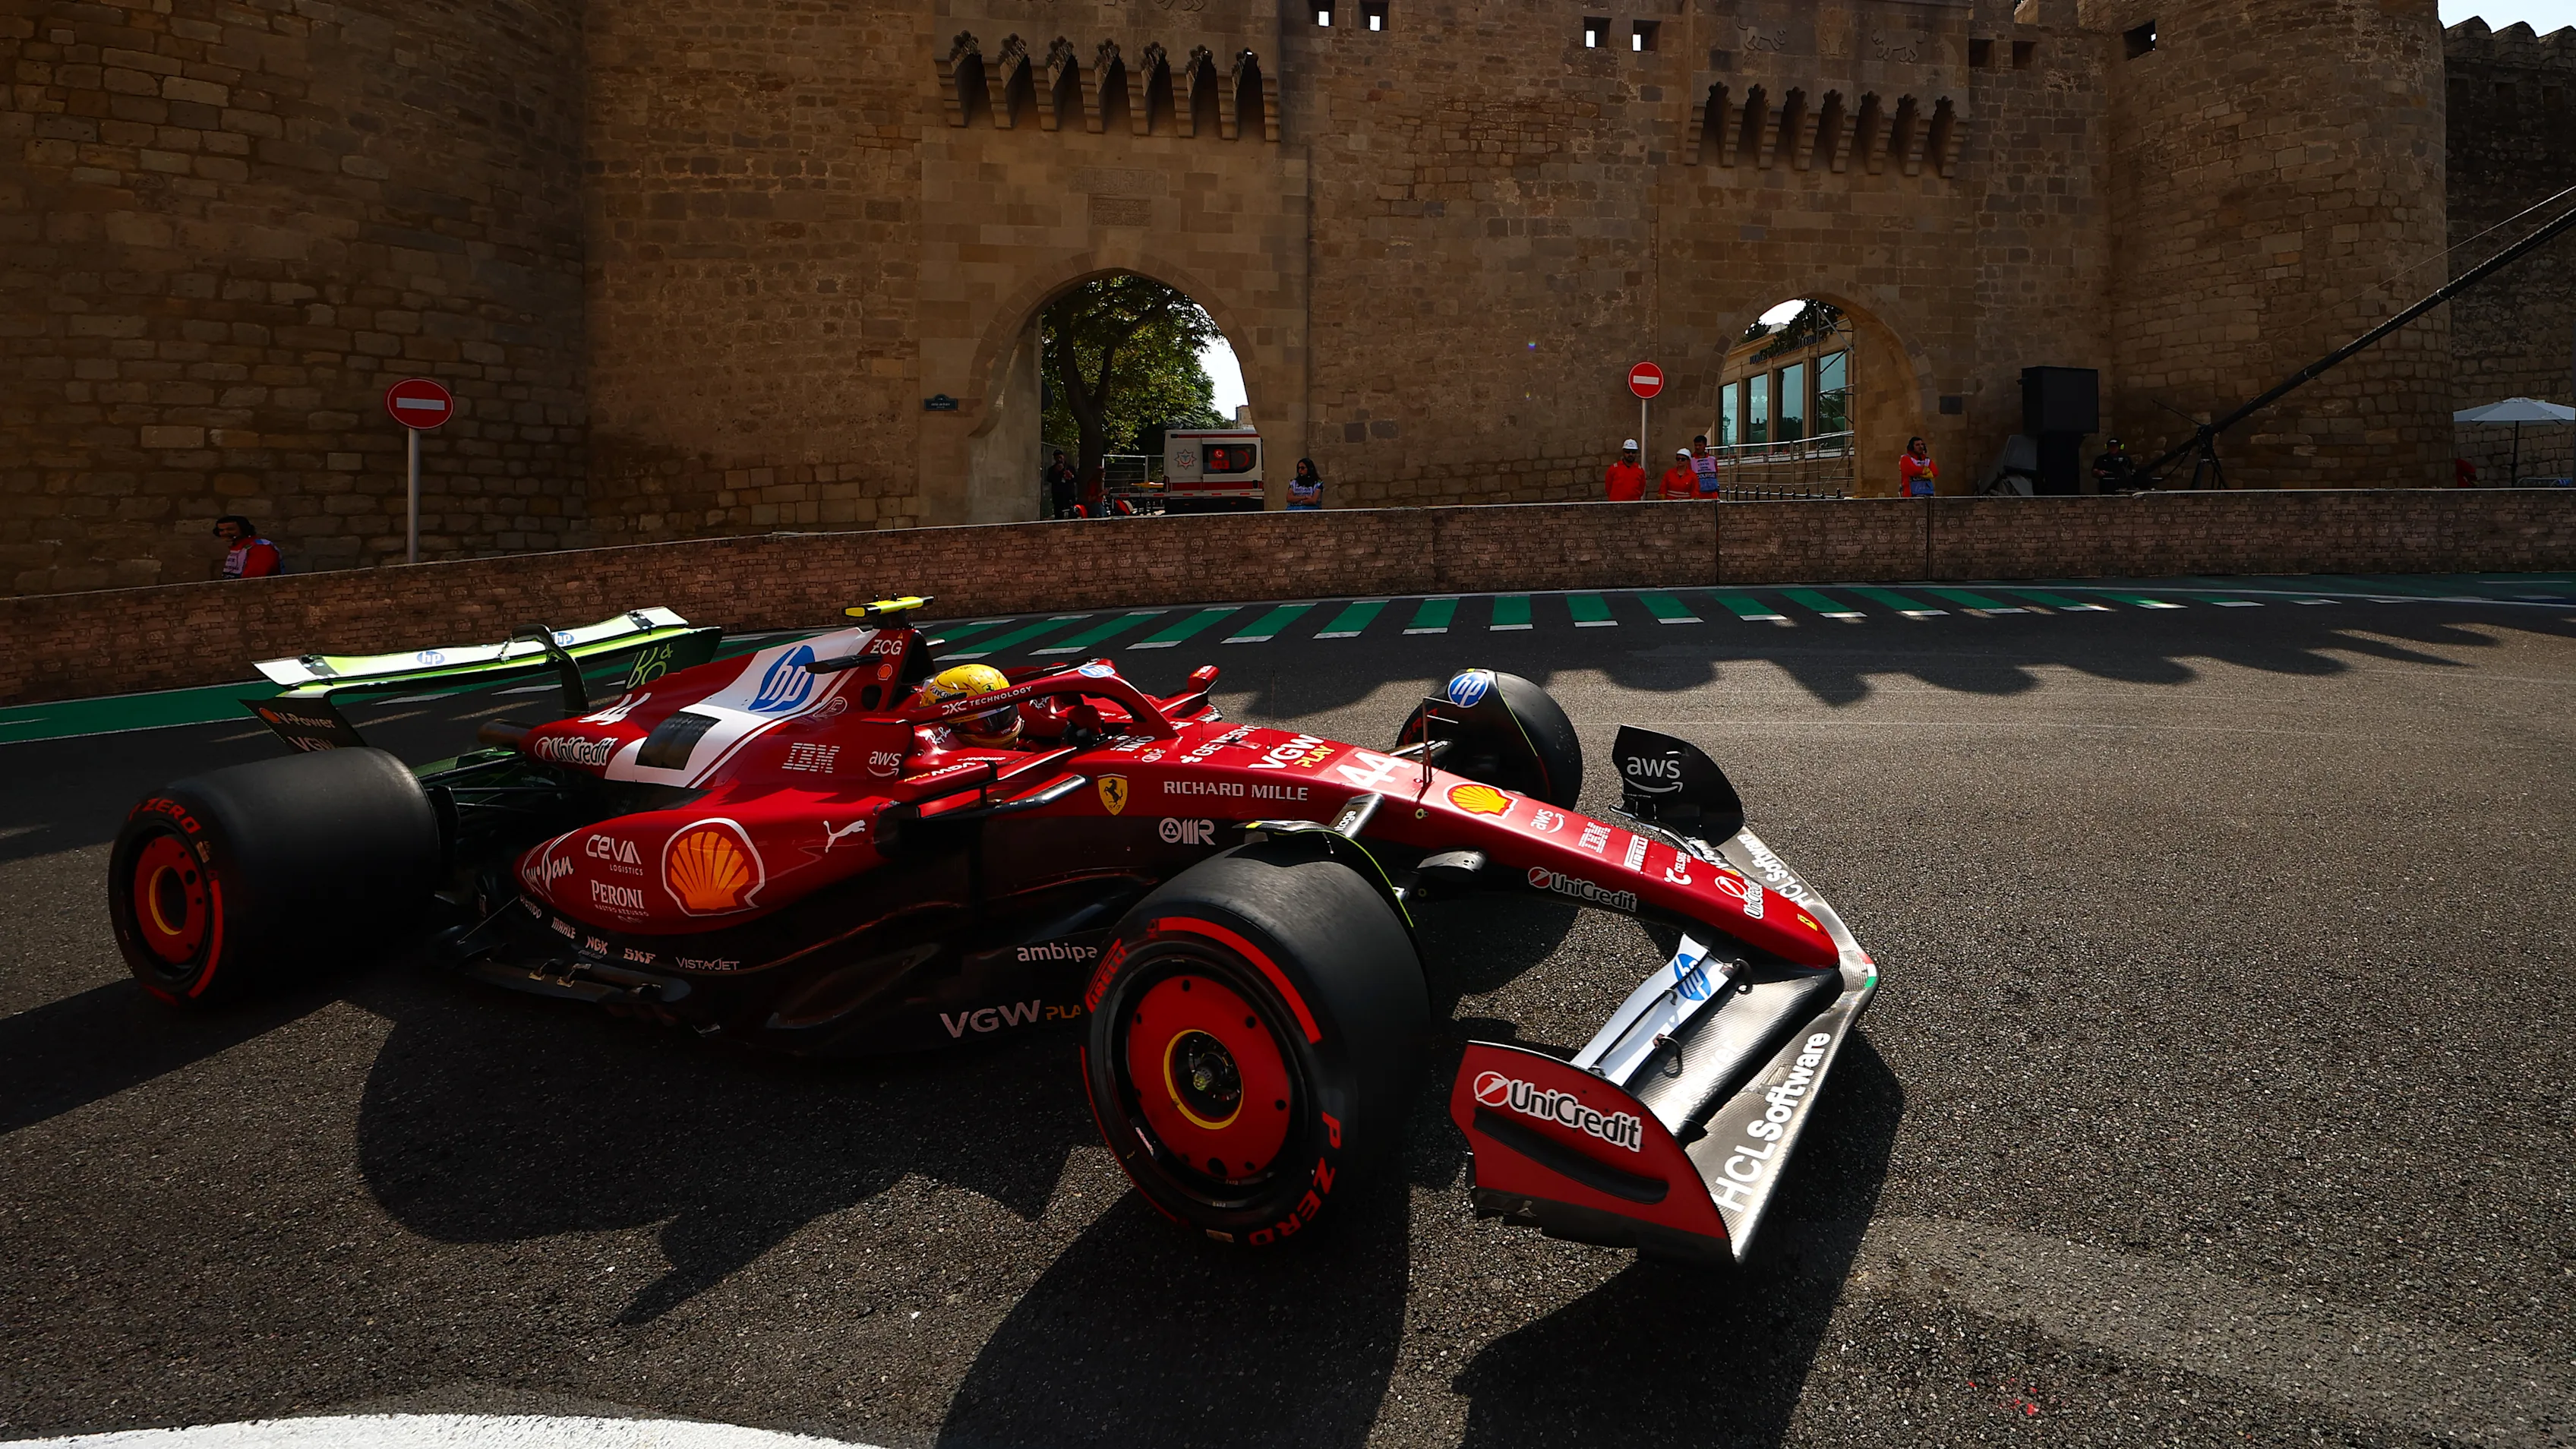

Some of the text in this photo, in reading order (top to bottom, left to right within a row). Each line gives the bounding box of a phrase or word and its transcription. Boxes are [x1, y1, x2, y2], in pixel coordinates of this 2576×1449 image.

[420, 651, 443, 665] hp
[870, 639, 902, 655] ZCG
[970, 686, 1032, 706] TECHNOLOGY
[1451, 674, 1485, 707] hp
[276, 710, 336, 729] V-Power
[578, 693, 652, 725] 44
[549, 737, 618, 766] UniCredit
[781, 743, 840, 773] IBM
[869, 751, 901, 767] aws
[1248, 734, 1336, 769] VGW PLAY
[1337, 751, 1413, 788] 44
[1627, 757, 1681, 779] aws
[1163, 781, 1309, 801] RICHARD MILLE
[141, 797, 203, 834] ZERO
[1530, 809, 1554, 831] aws
[1578, 821, 1612, 854] IBM
[1624, 835, 1649, 873] PIRELLI
[1673, 850, 1687, 873] CELSIUS
[610, 863, 643, 876] LOGISTICS
[591, 879, 646, 909] PERONI
[1551, 874, 1637, 911] UniCredit
[551, 916, 577, 940] MAHLE
[585, 935, 609, 956] NGK
[623, 948, 656, 965] SKF
[939, 999, 1081, 1038] VGW PLA
[1321, 1111, 1341, 1148] P
[1507, 1078, 1643, 1153] UniCredit
[1709, 1031, 1831, 1213] HCLSoftware
